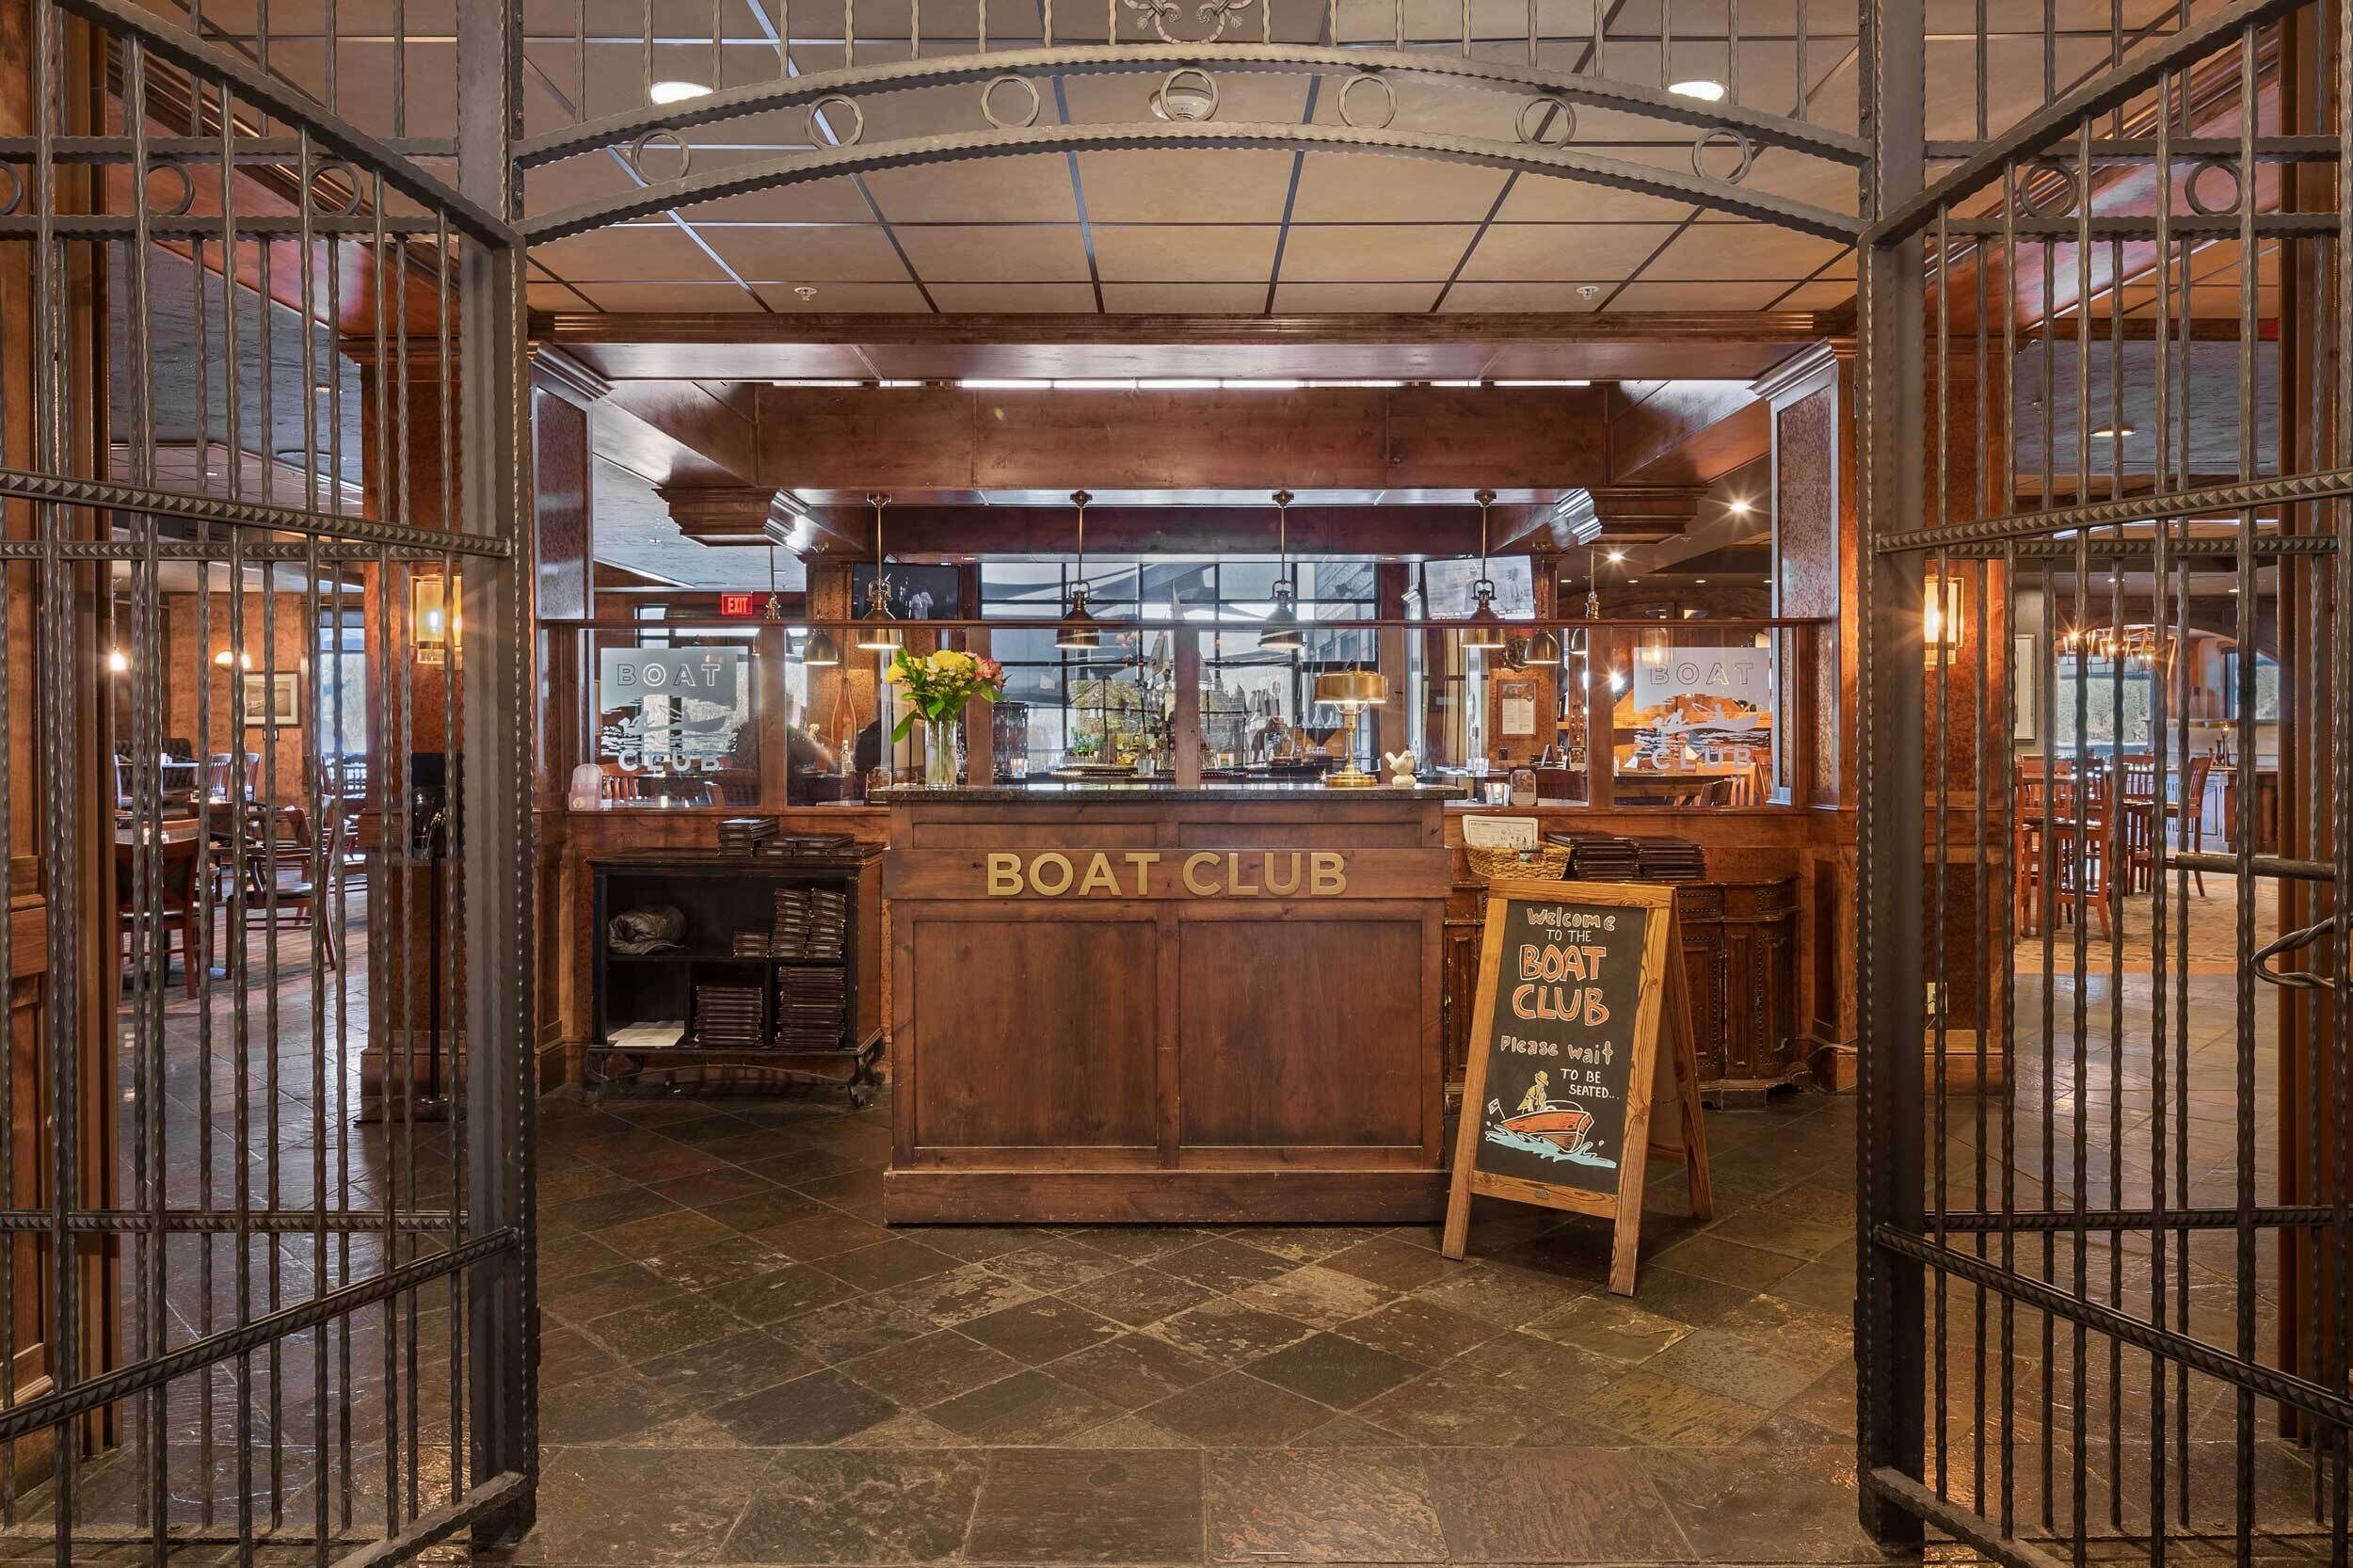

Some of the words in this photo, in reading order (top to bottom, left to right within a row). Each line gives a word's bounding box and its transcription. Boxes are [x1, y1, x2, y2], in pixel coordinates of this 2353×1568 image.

[728, 596, 748, 614] EXIT
[616, 664, 720, 686] BOAT
[1650, 663, 1754, 685] BOAT
[618, 750, 720, 773] CLUB
[1652, 747, 1752, 772] CLUB
[987, 852, 1160, 897] BOAT
[1182, 852, 1347, 897] CLUB
[1528, 907, 1615, 932] Welcome
[1547, 930, 1562, 940] TO
[1569, 930, 1592, 942] THE
[1520, 945, 1606, 982] BOAT
[1513, 984, 1610, 1026] CLUB
[1501, 1035, 1559, 1057] Please
[1568, 1040, 1612, 1064] wait
[1561, 1068, 1579, 1080] TO
[1586, 1070, 1601, 1083] BE
